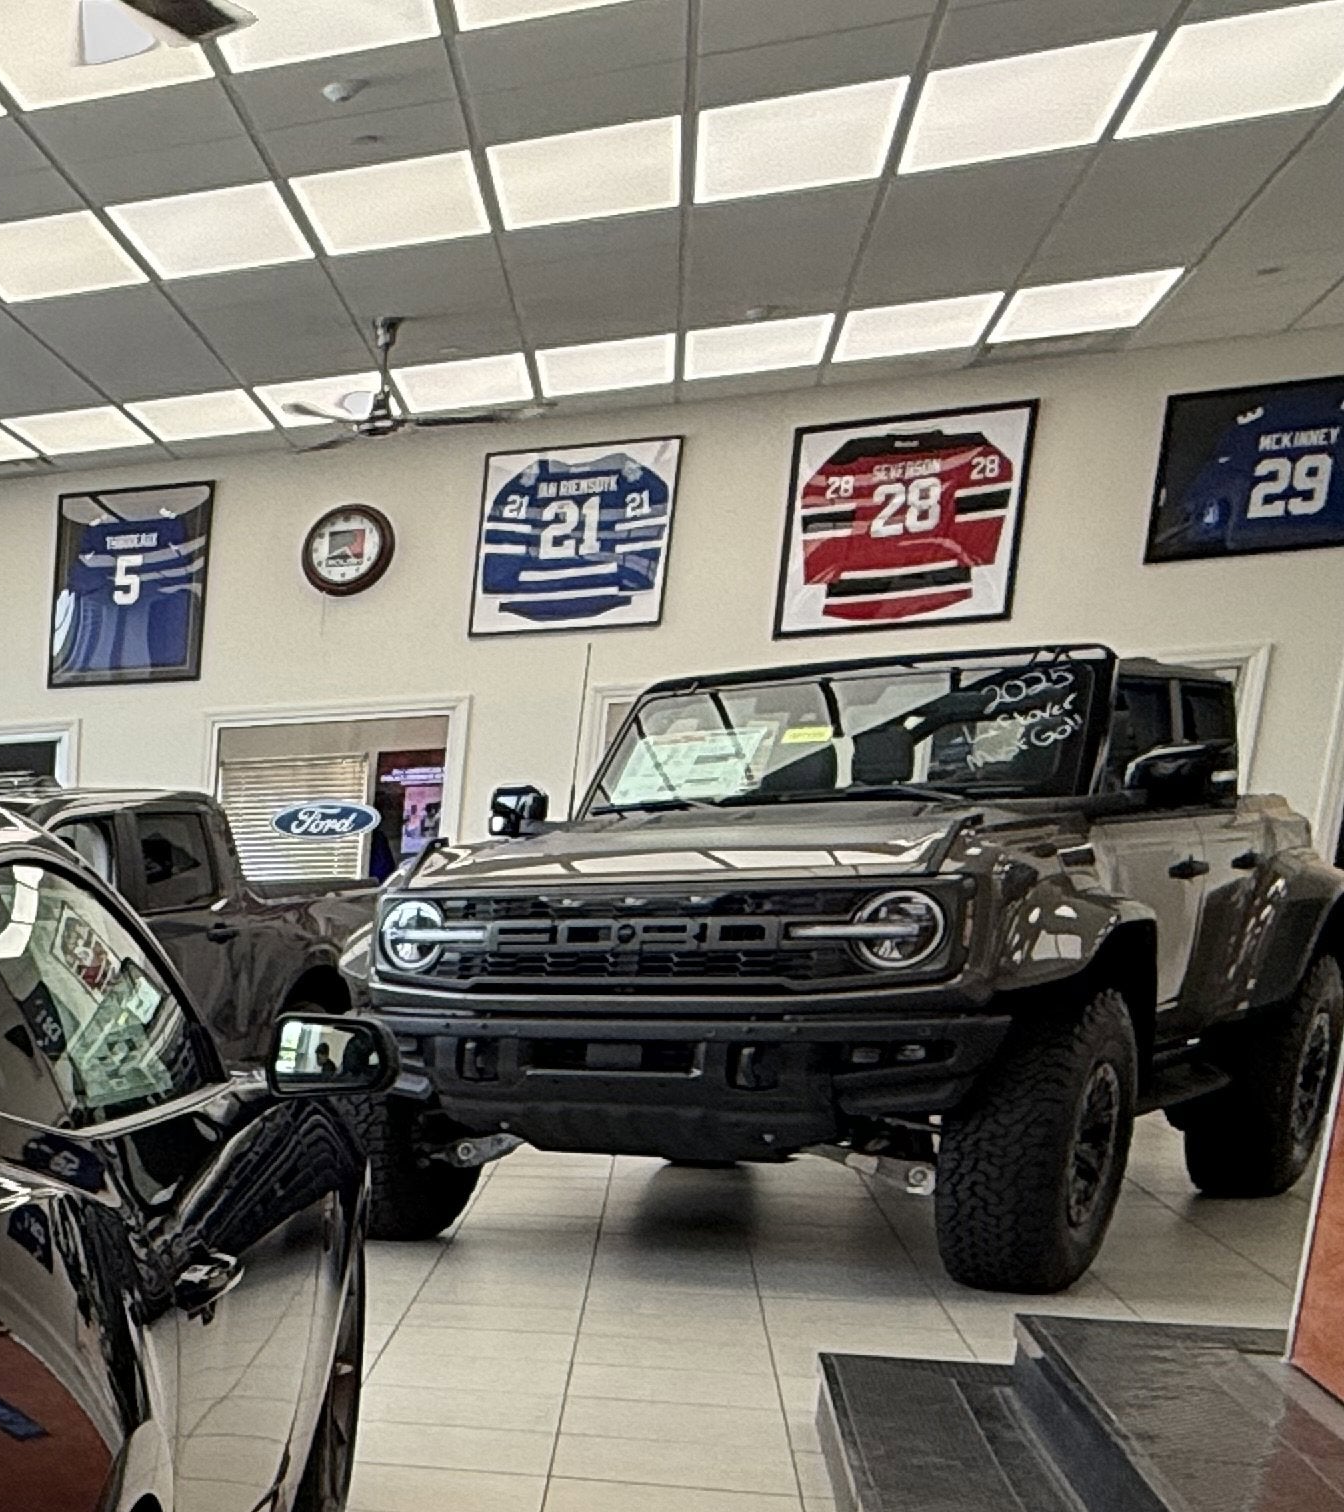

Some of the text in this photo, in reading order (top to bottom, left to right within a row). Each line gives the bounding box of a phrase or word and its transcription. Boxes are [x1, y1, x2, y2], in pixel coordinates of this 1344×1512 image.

[872, 458, 942, 482] SEVERSON
[970, 455, 1000, 480] 28
[625, 489, 652, 518] 21
[825, 475, 854, 500] 28
[1247, 453, 1333, 519] 29
[502, 495, 530, 520] 21
[870, 477, 941, 537] 28
[539, 495, 602, 560] 21
[113, 554, 143, 606] 5
[981, 665, 1075, 714] 2025
[487, 916, 782, 952] FORD
